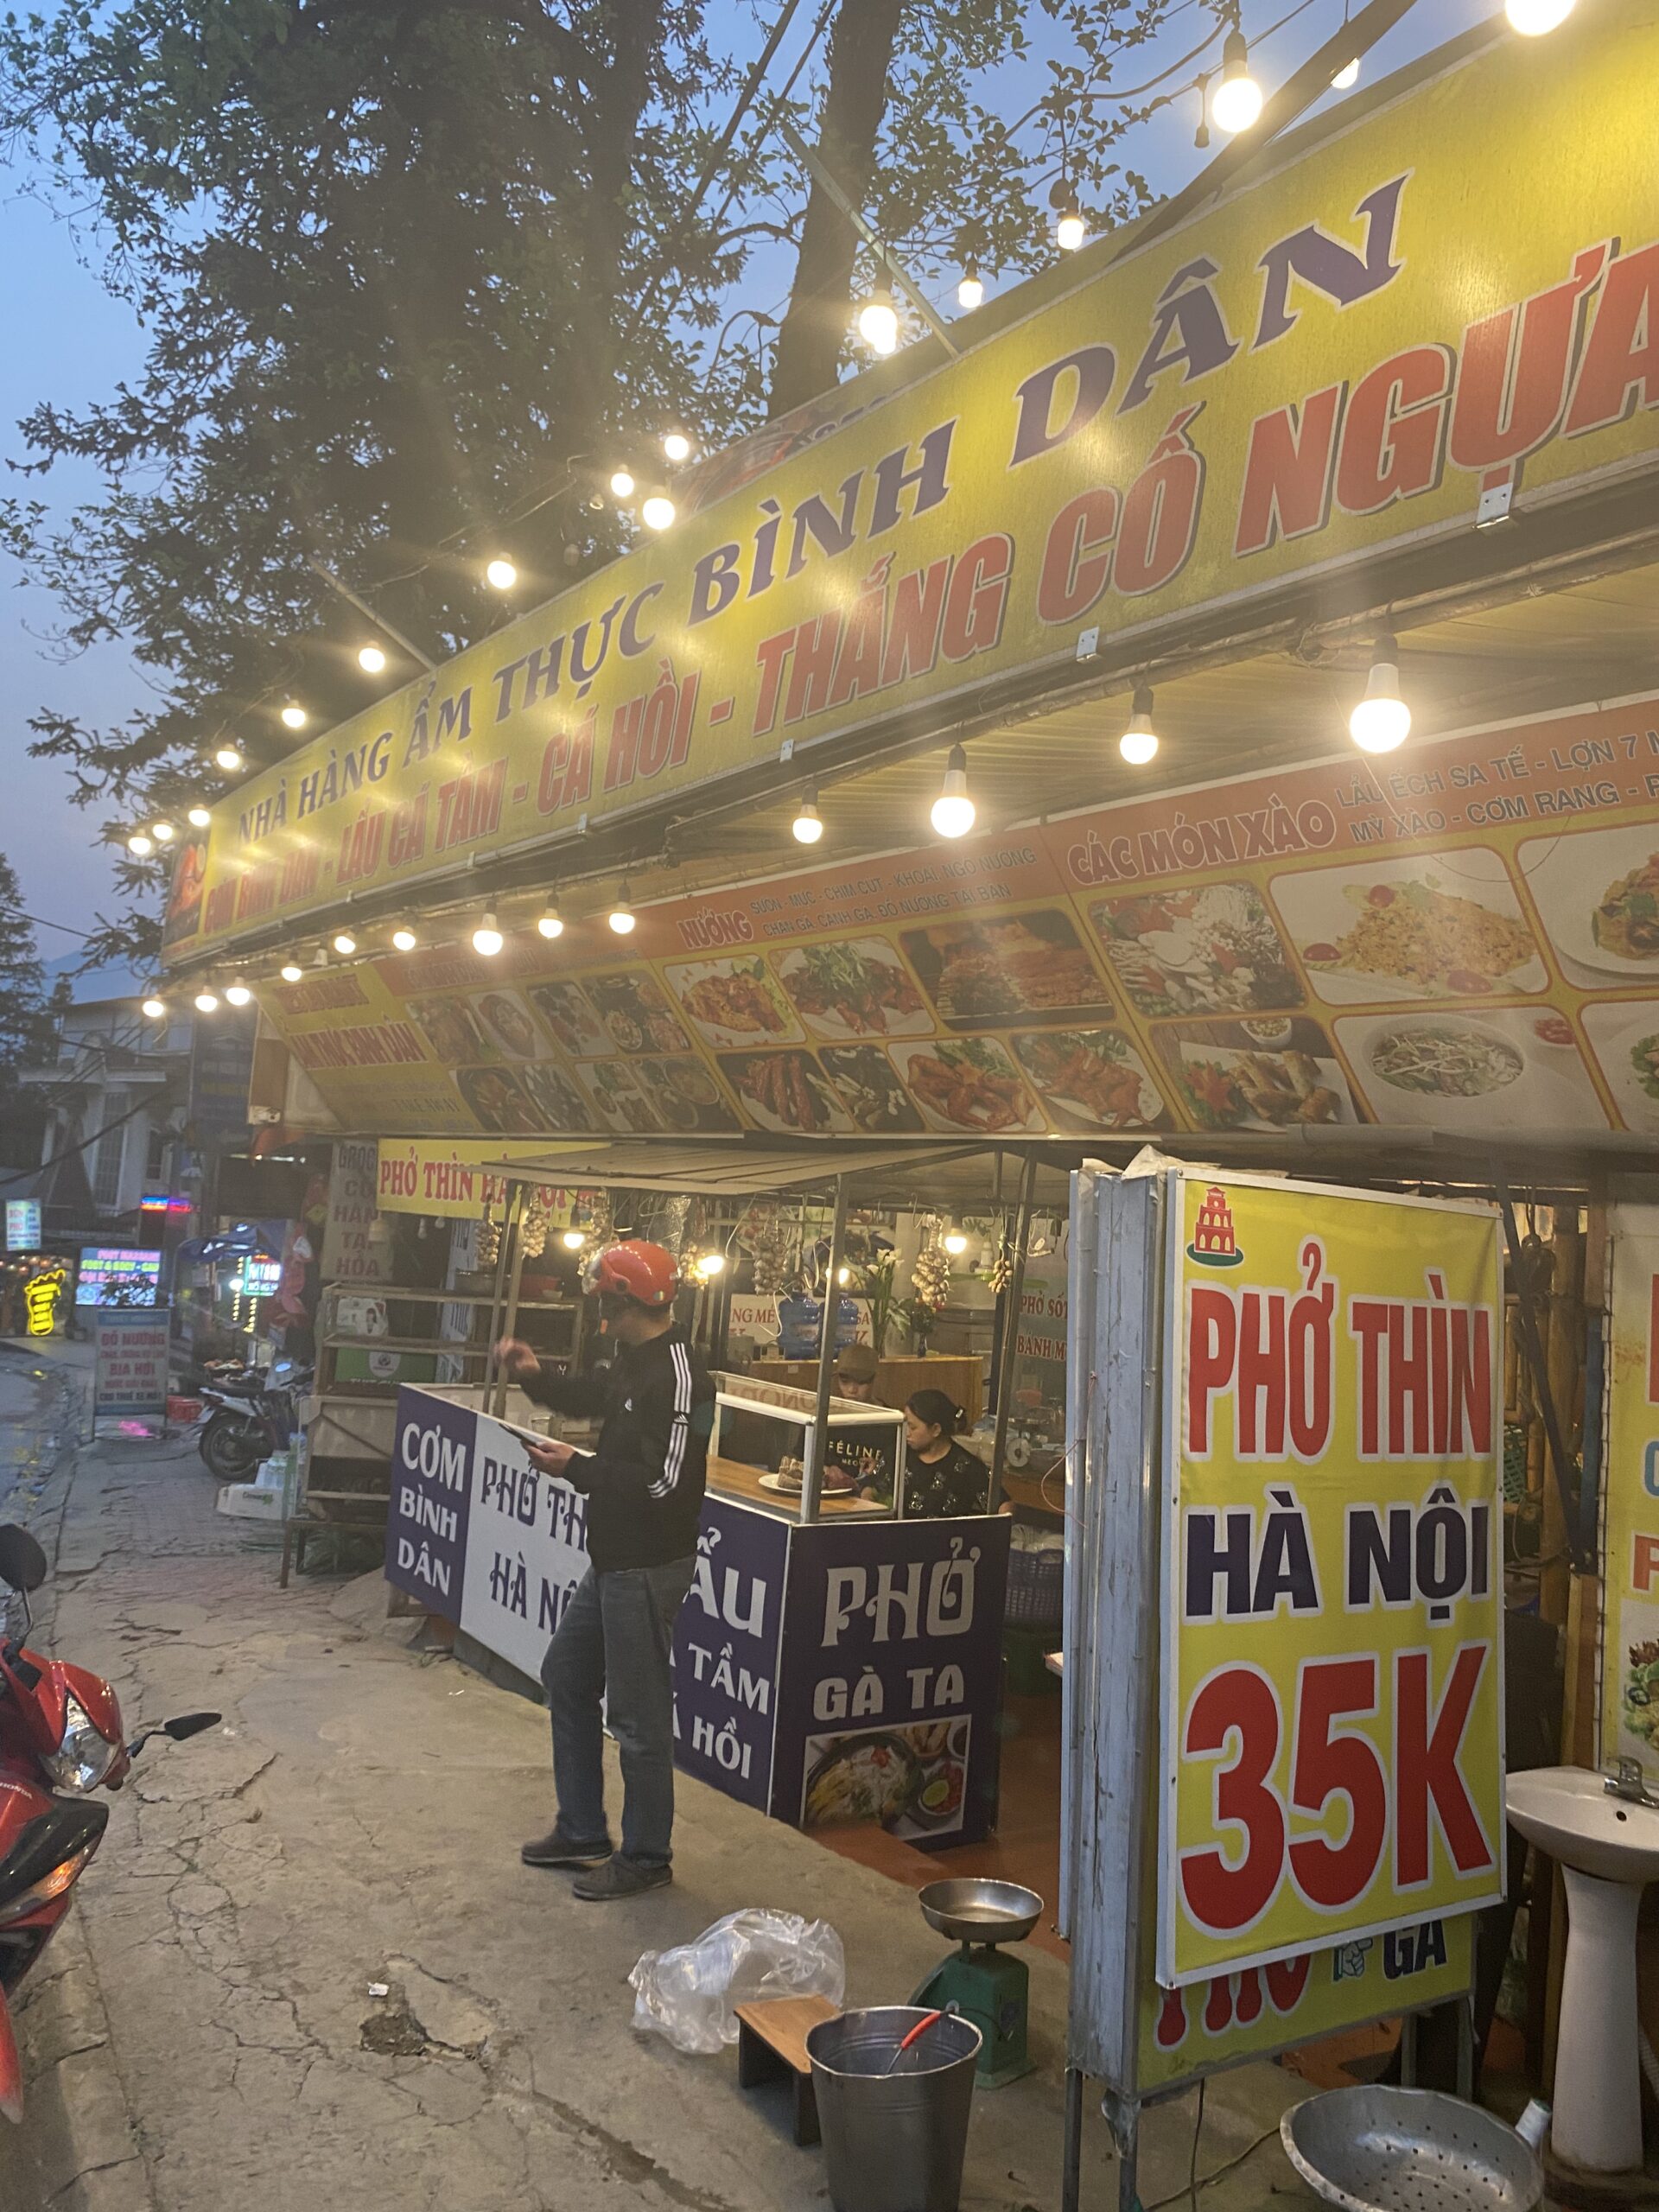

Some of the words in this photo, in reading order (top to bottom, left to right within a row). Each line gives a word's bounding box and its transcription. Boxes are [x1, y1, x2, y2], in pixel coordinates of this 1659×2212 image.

[239, 779, 287, 844] NHÀ
[297, 732, 392, 819] HÀNG
[403, 680, 472, 768] ẨM
[493, 582, 664, 724] THỰC
[687, 418, 957, 627] BÌNH
[1008, 169, 1414, 469] DÂN
[336, 797, 386, 886] LẨU
[388, 780, 429, 870] CÁ
[435, 750, 509, 853] TẦM
[537, 703, 600, 816] CÁ
[604, 658, 702, 791] HỒI
[753, 532, 1015, 737] THẮNG
[1039, 401, 1208, 626] CỐ
[1233, 235, 1659, 557] NGỰA
[1335, 772, 1383, 809] LẨU
[1389, 767, 1445, 799] ẾCH
[1450, 763, 1488, 789] SA
[1488, 744, 1531, 781] TẾ
[1551, 739, 1616, 772] LỢN
[1618, 734, 1637, 759] 7
[1067, 830, 1140, 886] CÁC
[1138, 811, 1238, 875] MÓN
[1236, 792, 1337, 860] XÀO
[1350, 812, 1384, 844] MỲ
[1390, 808, 1446, 837] XÀO
[1466, 796, 1529, 824] CƠM
[1535, 781, 1621, 815] RANG
[677, 906, 753, 949] NƯỚNG
[379, 1146, 418, 1197] PHỞ
[423, 1152, 473, 1202] THÌN
[1189, 1243, 1334, 1457] PHỞ
[1352, 1274, 1491, 1455] THÌN
[401, 1421, 466, 1493] CƠM
[399, 1486, 457, 1542] BÌNH
[480, 1456, 540, 1526] PHỞ
[547, 1484, 589, 1552] TH
[397, 1537, 451, 1598] DÂN
[489, 1550, 527, 1619] HÀ
[683, 1527, 767, 1638] ẨU
[1185, 1491, 1319, 1616] HÀ
[1349, 1487, 1488, 1620] NỘI
[821, 1536, 982, 1647] PHỞ
[688, 1643, 770, 1715] TẦM
[813, 1666, 884, 1721] GÀ
[906, 1664, 964, 1710] TA
[692, 1716, 752, 1780] HỒI
[1181, 1646, 1493, 1929] 35K
